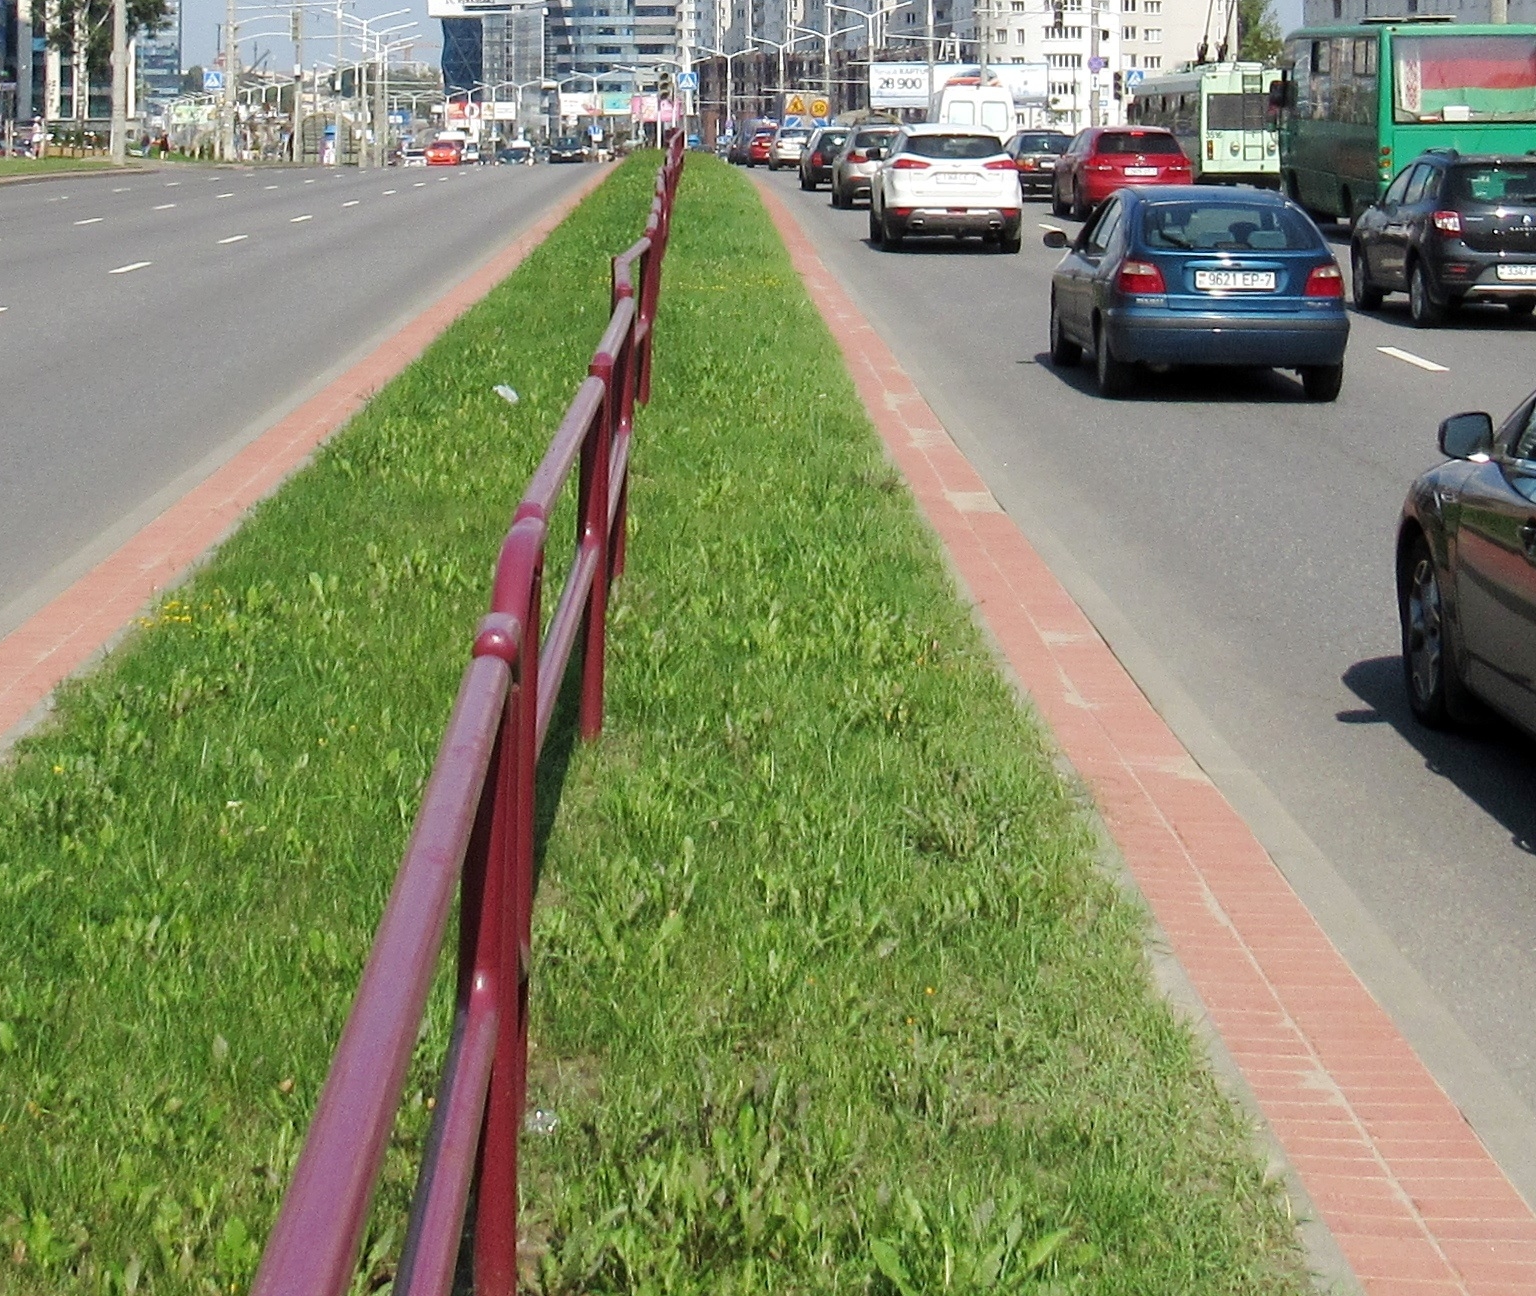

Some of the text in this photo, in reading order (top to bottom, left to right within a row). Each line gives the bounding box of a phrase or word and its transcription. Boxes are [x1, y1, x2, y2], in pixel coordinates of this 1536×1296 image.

[879, 77, 923, 89] 28 900
[1208, 274, 1272, 286] 9621 EP-7
